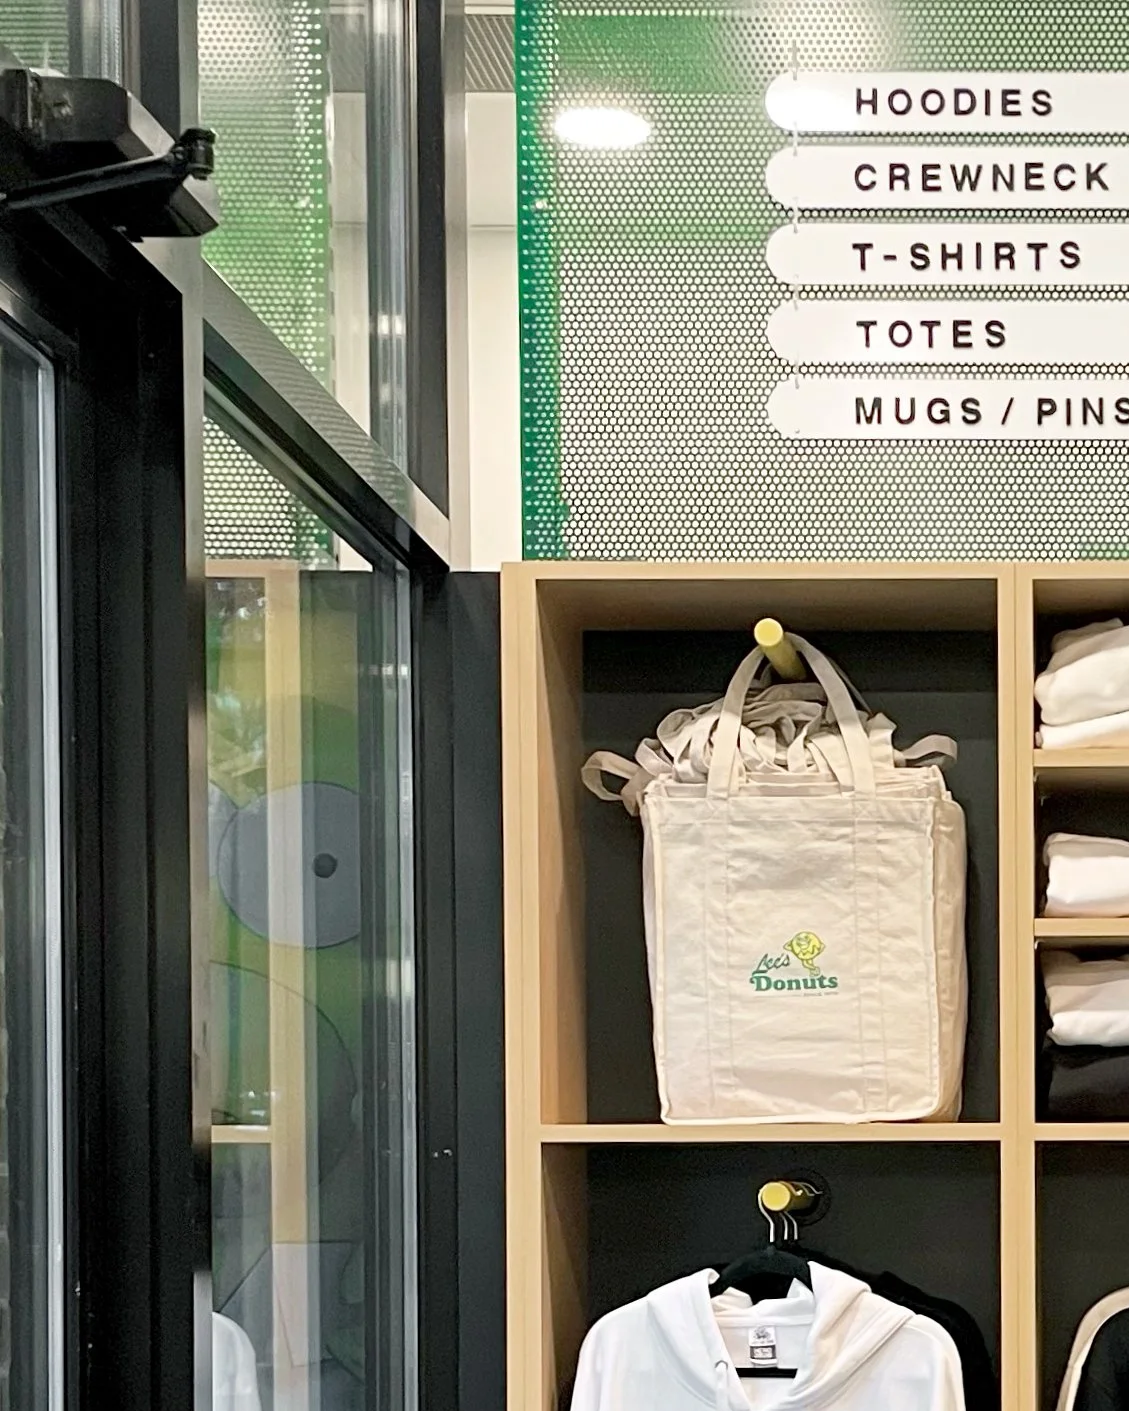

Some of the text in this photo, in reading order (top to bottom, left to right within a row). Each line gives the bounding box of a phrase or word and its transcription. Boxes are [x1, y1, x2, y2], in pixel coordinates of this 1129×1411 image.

[856, 88, 1053, 117] HOODIES
[854, 162, 1109, 192] CREWNECK
[852, 241, 1081, 271] T-SHIRTS
[856, 319, 1007, 349] TOTES
[855, 397, 983, 426] MUGS
[750, 975, 838, 992] Donuts
